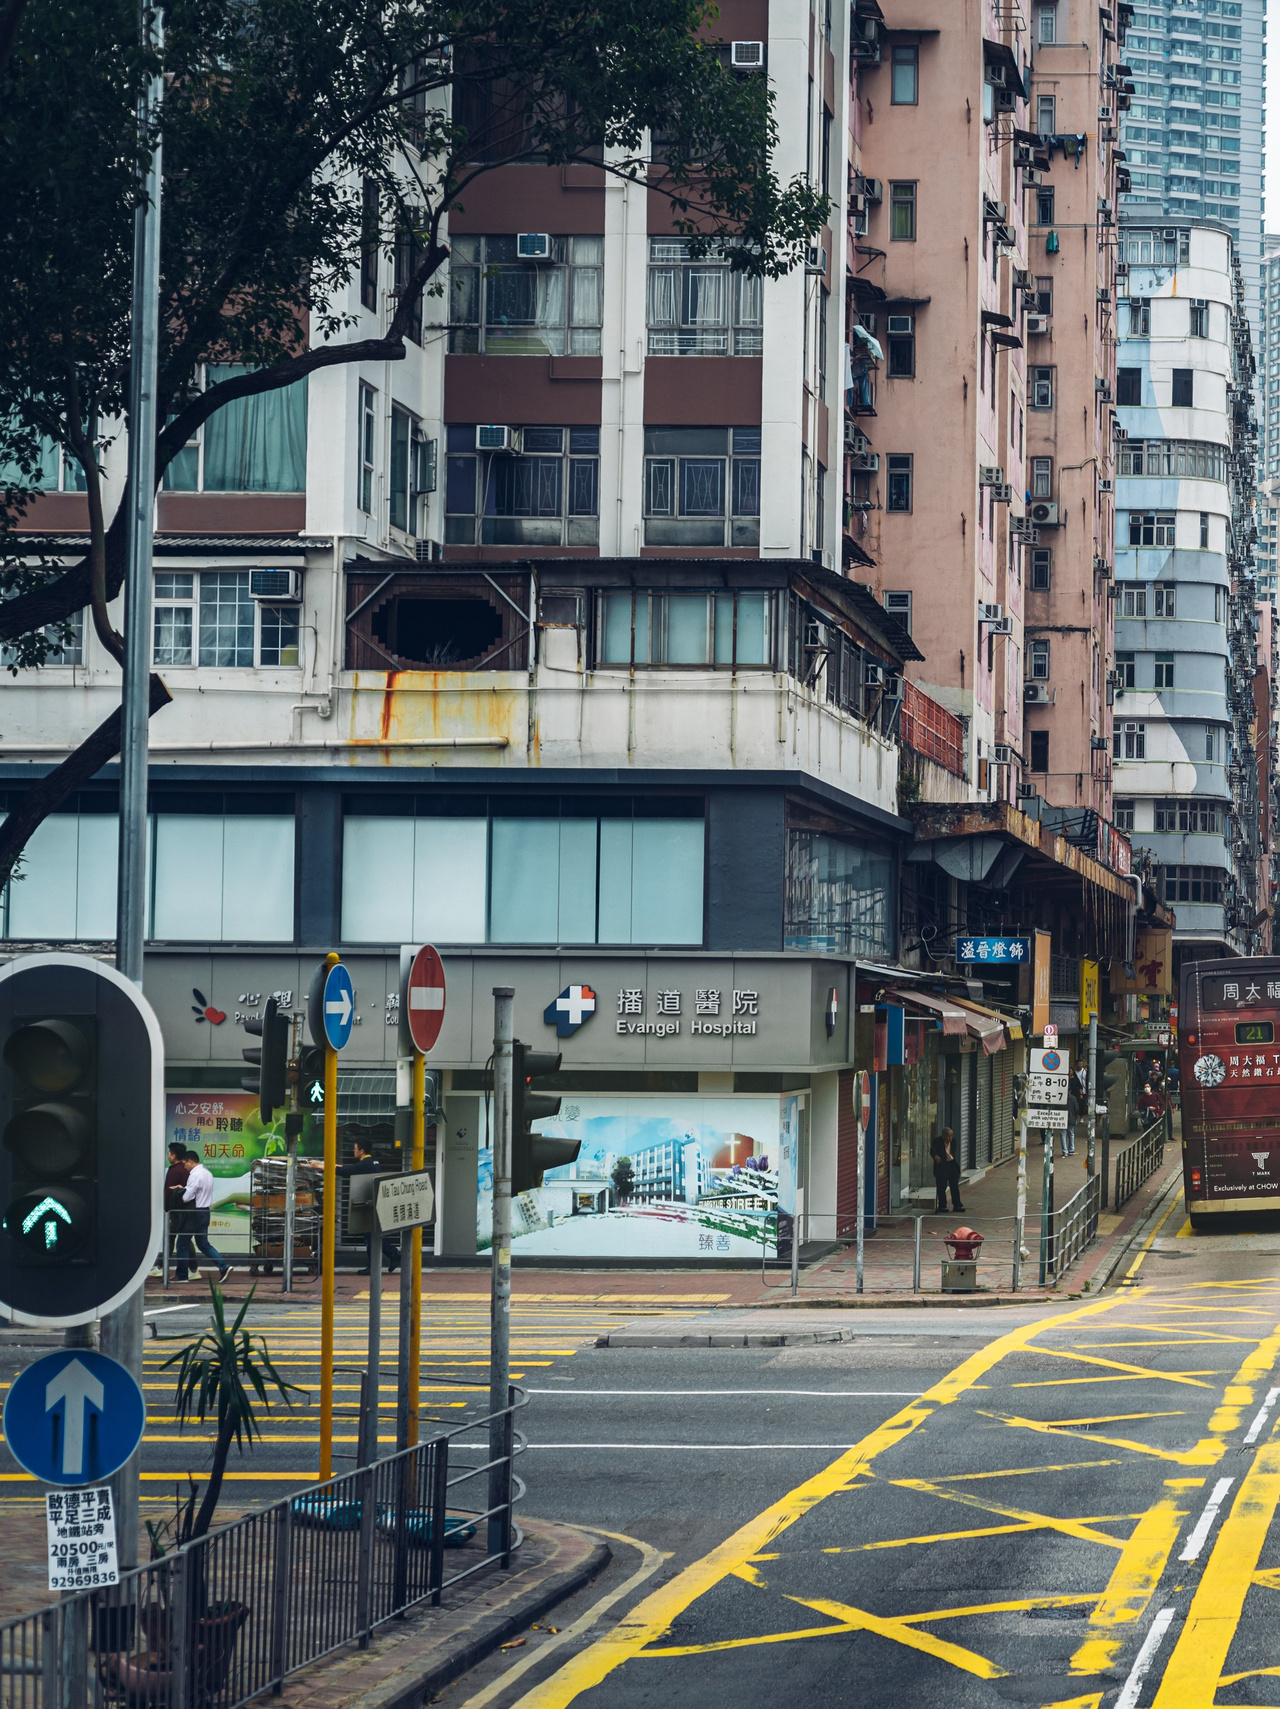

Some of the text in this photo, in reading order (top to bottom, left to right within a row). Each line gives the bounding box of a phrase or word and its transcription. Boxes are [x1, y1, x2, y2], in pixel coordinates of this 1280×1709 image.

[961, 941, 1024, 960] 溢晉燈飾
[617, 988, 758, 1015] 播道醫院
[616, 1020, 756, 1037] Evangel Hospital
[1246, 1026, 1263, 1040] 21
[1229, 1054, 1266, 1066] 周大福
[1273, 1054, 1280, 1064] T
[1045, 1078, 1067, 1088] 8-10
[1044, 1092, 1063, 1101] 5-7
[175, 1102, 224, 1115] 心之安舒
[196, 1117, 243, 1132] 用心聆聽
[174, 1127, 201, 1142] 情緒
[203, 1144, 244, 1158] 知天命
[381, 1178, 428, 1198] Ma Tau Chung Road
[1213, 1184, 1247, 1192] Exclusively
[1256, 1182, 1279, 1190] CHOW
[49, 1505, 112, 1526] 平足三成
[57, 1523, 105, 1538] 地鐵站旁
[86, 1552, 109, 1566] 三房
[51, 1571, 116, 1588] 92969836
